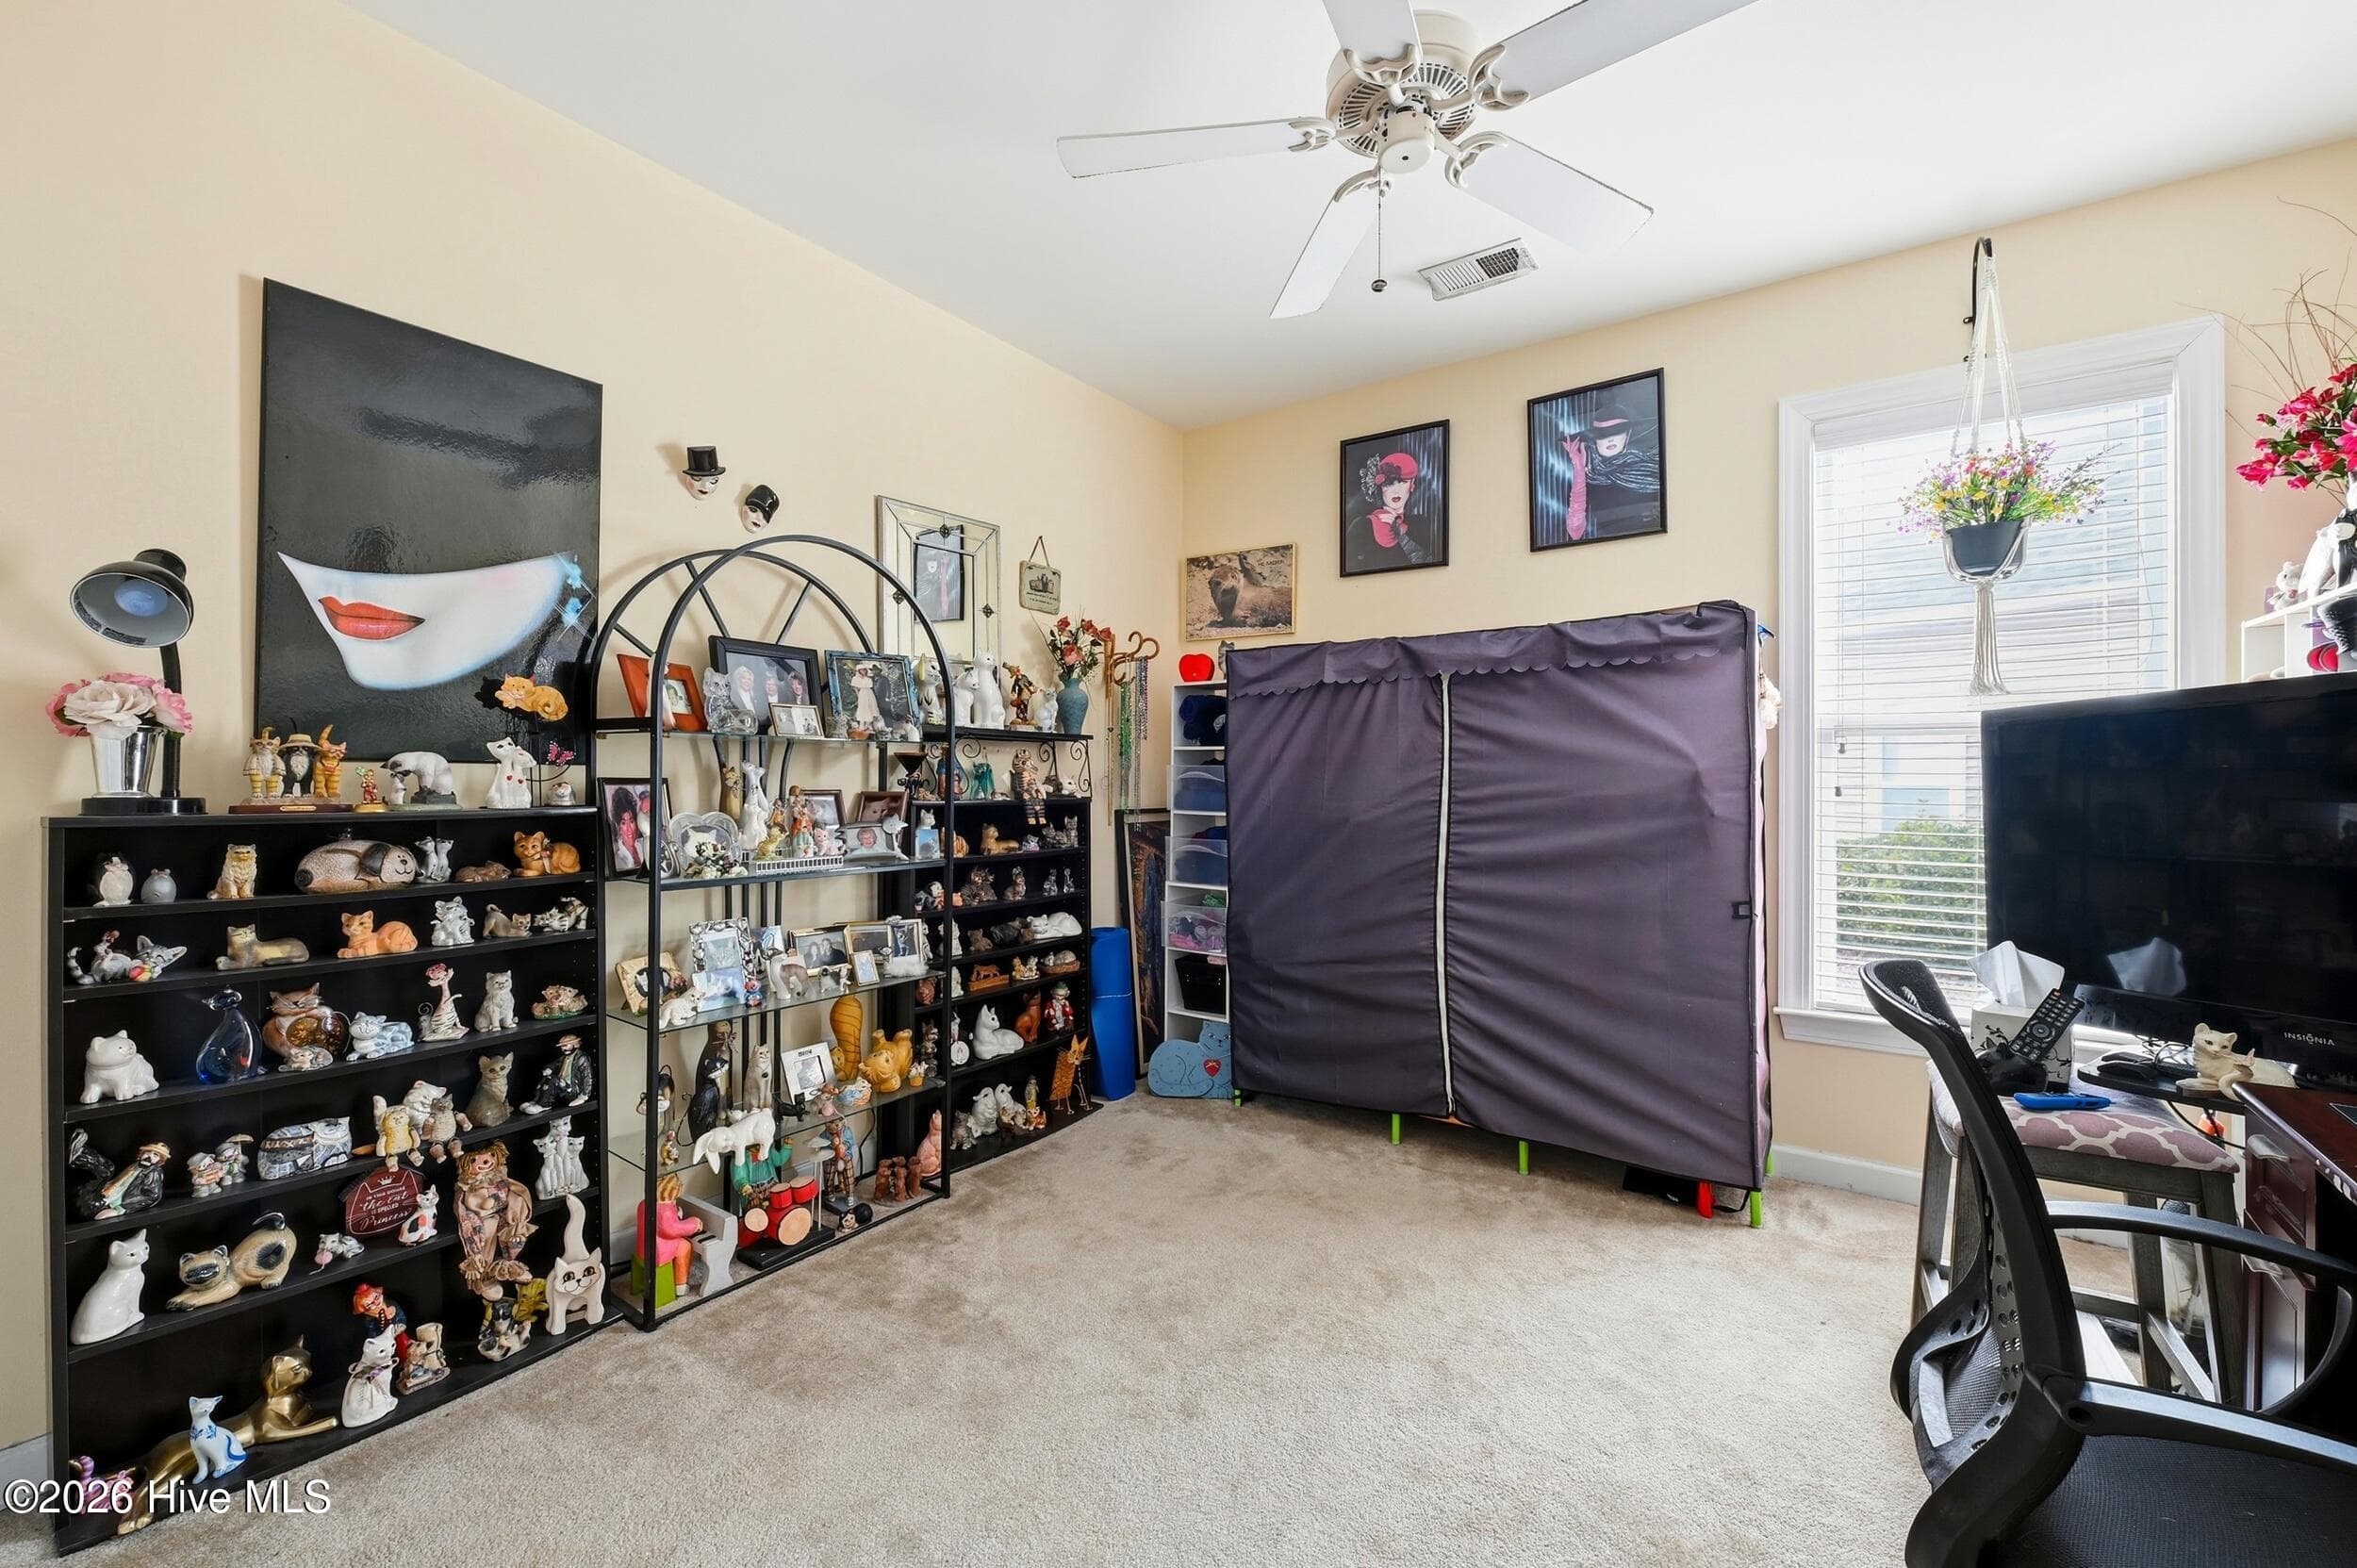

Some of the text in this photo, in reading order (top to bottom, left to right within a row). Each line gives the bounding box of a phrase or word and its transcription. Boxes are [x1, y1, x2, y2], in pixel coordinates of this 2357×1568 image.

[2283, 1032, 2335, 1046] INSIGNIA
[360, 1191, 409, 1212] the cat
[377, 1202, 399, 1213] SPELLED
[360, 1207, 412, 1230] Princess
